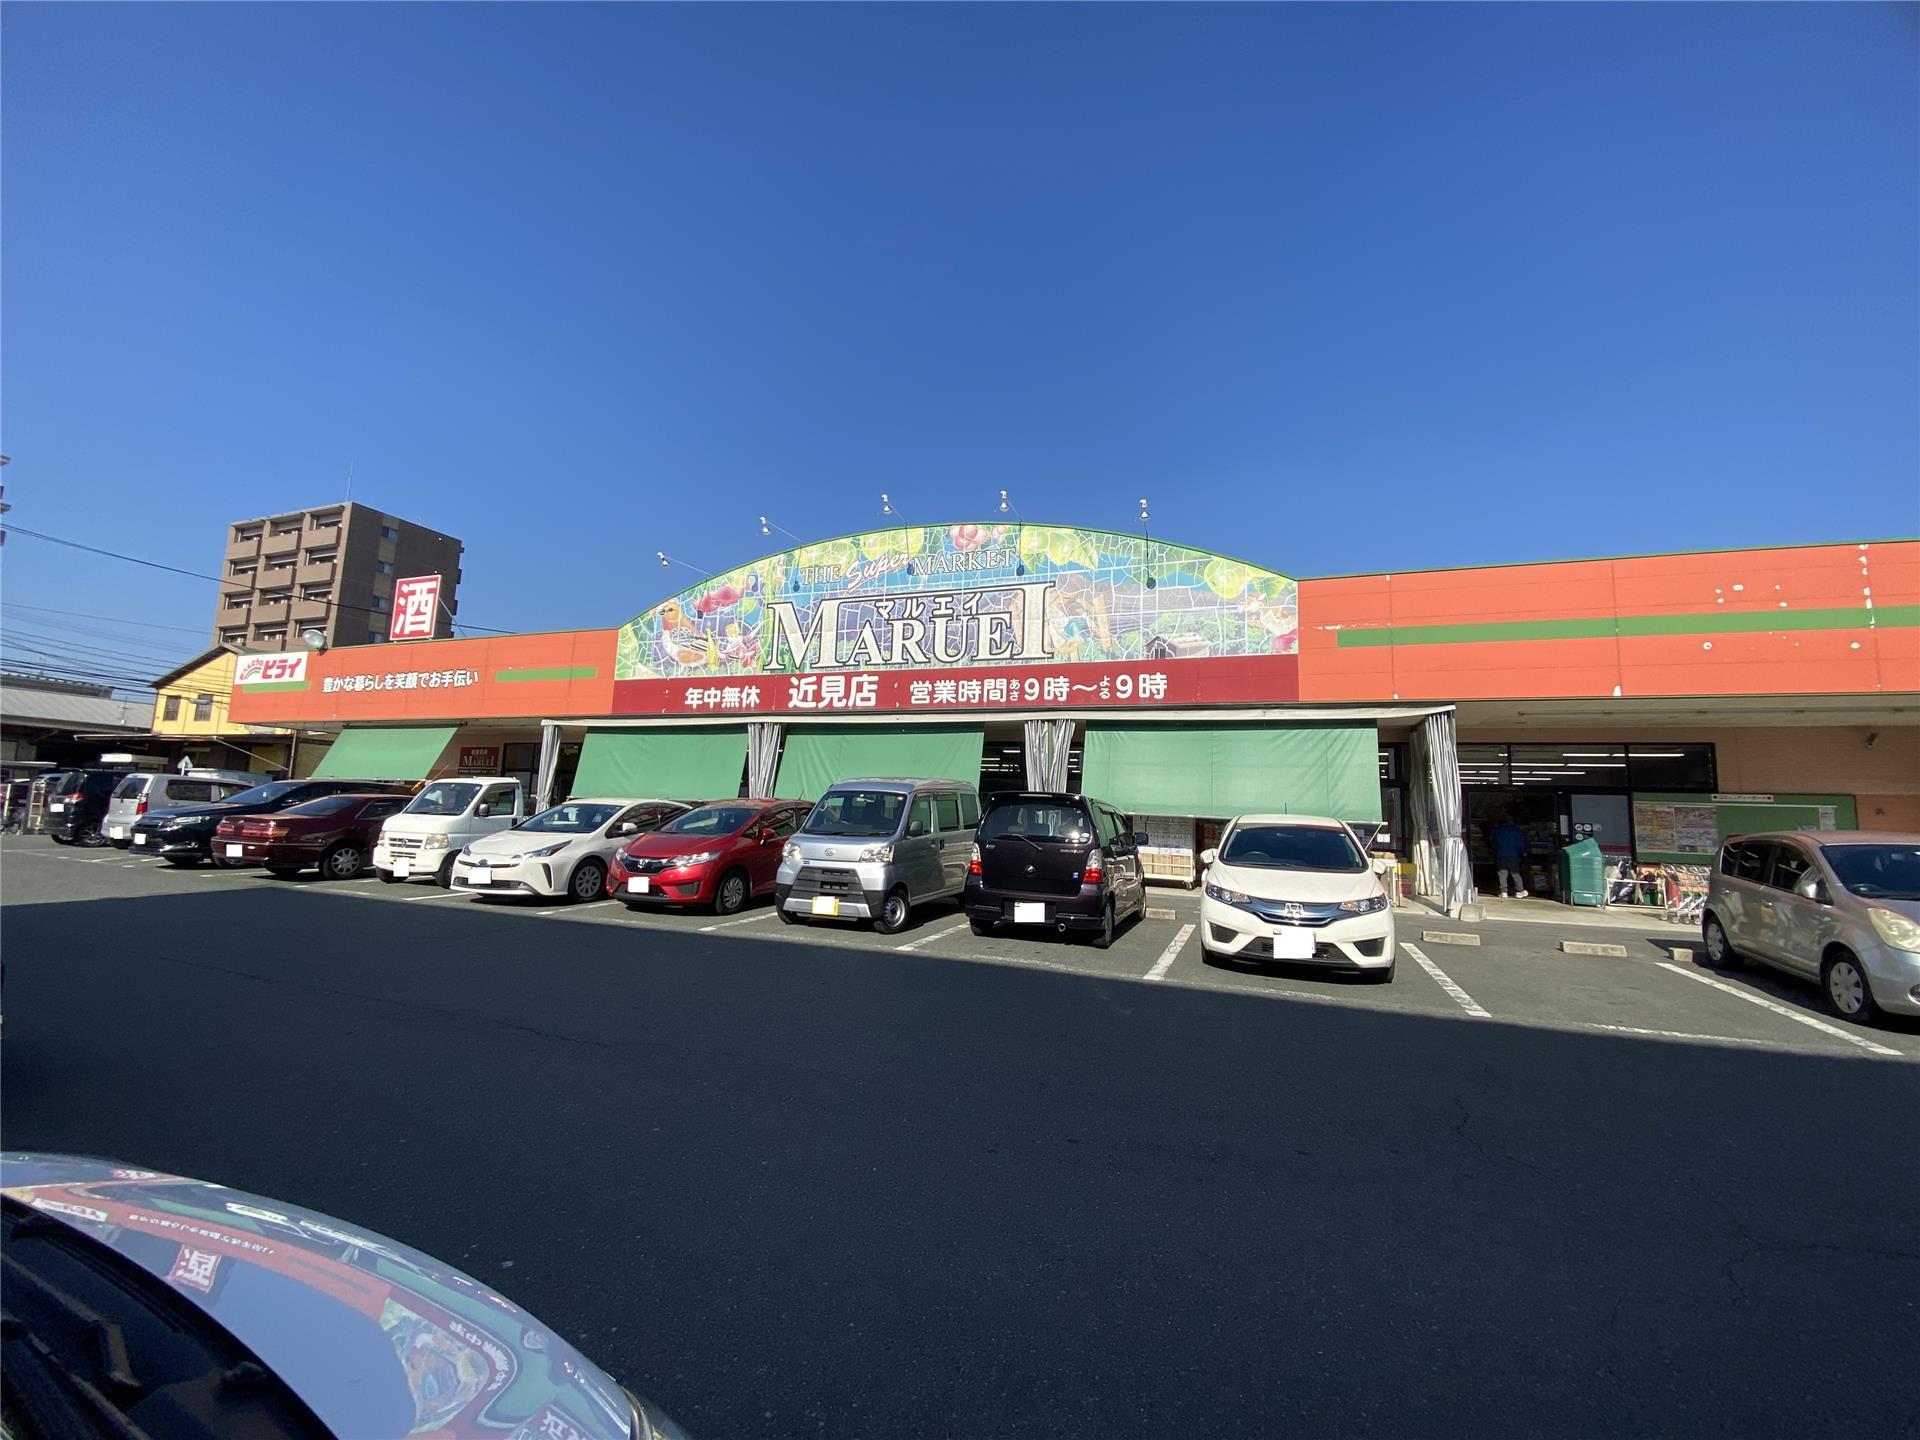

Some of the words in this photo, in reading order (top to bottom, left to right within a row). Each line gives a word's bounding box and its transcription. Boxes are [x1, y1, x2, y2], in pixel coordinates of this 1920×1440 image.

[801, 564, 841, 586] THE
[846, 552, 911, 593] Super
[912, 548, 1016, 577] MARKET
[394, 581, 438, 635] 酒
[875, 592, 982, 620] マルエイ
[763, 581, 1057, 671] MARUEI
[262, 658, 302, 679] ヒライ
[322, 669, 479, 693] 豊かな暮らしを笑顔でお手伝い
[684, 685, 760, 709] 年中無休
[788, 673, 879, 709] 近見店
